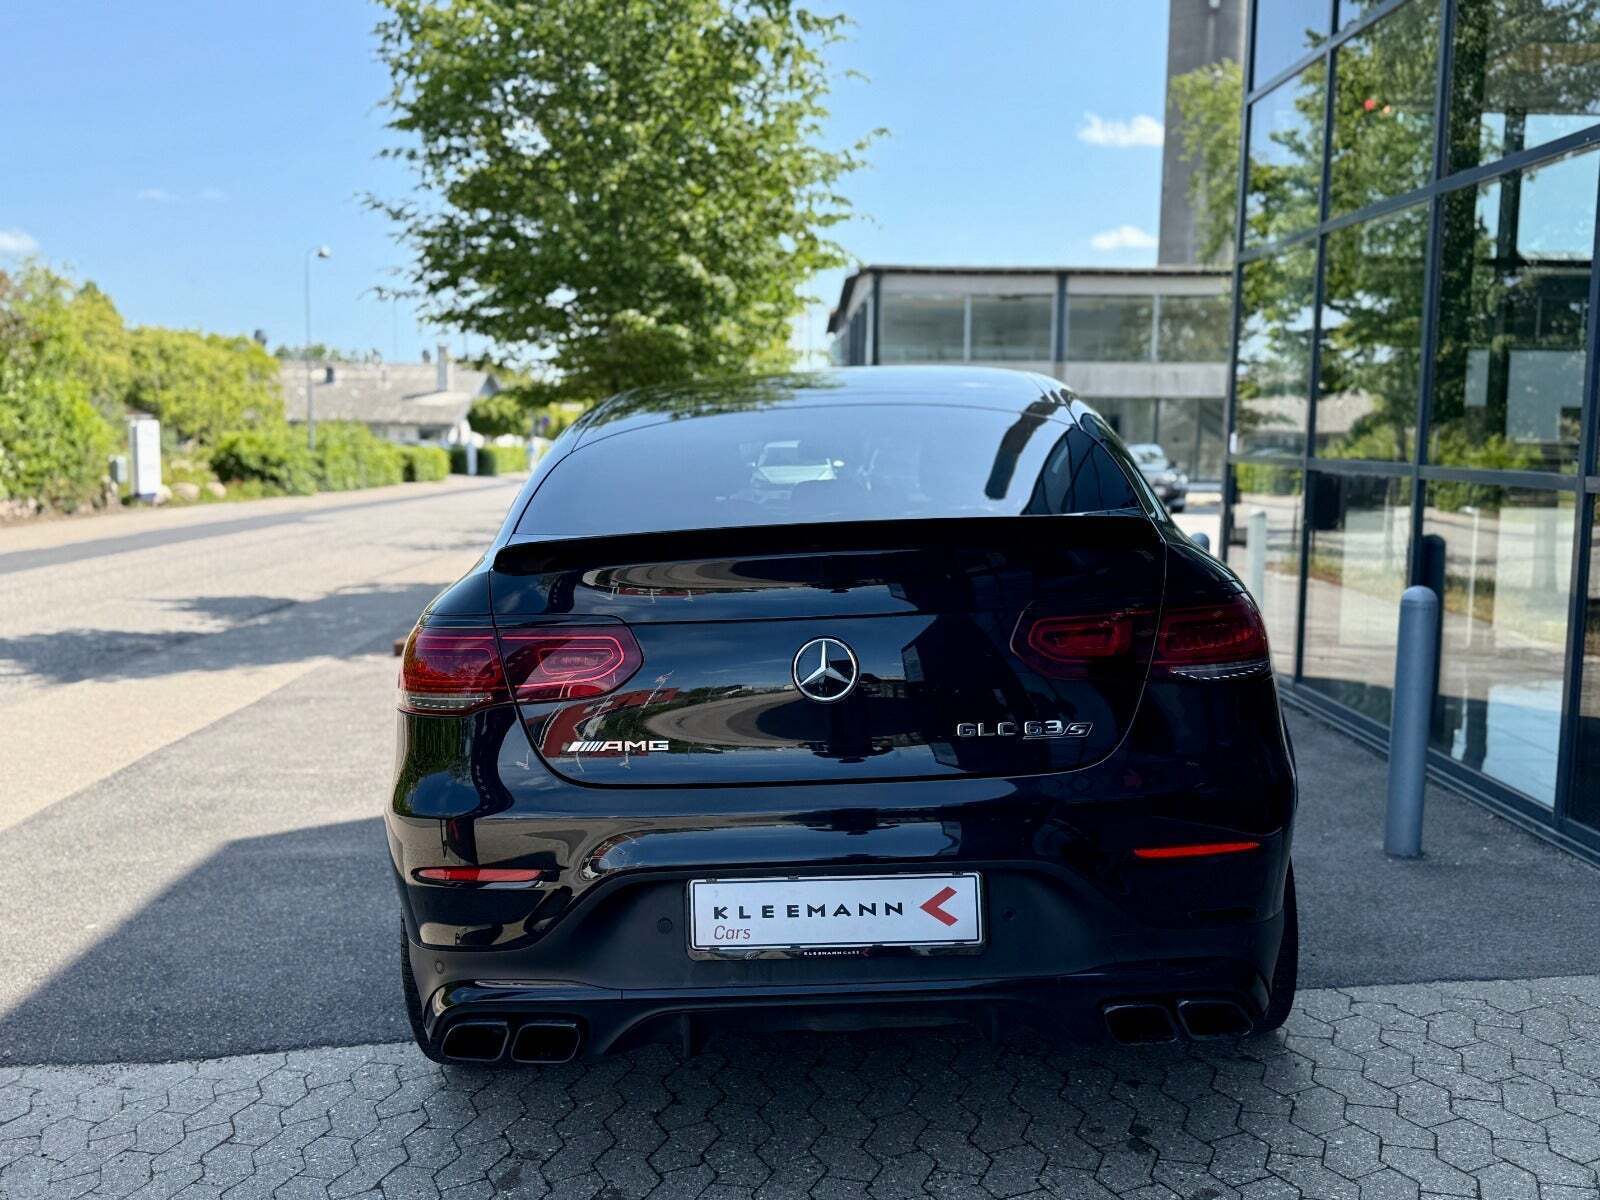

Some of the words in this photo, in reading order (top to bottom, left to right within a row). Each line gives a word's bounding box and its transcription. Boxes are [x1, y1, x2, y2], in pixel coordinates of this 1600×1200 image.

[956, 721, 1017, 737] GLC
[713, 901, 904, 920] KLEEMANN
[713, 924, 751, 941] Cars
